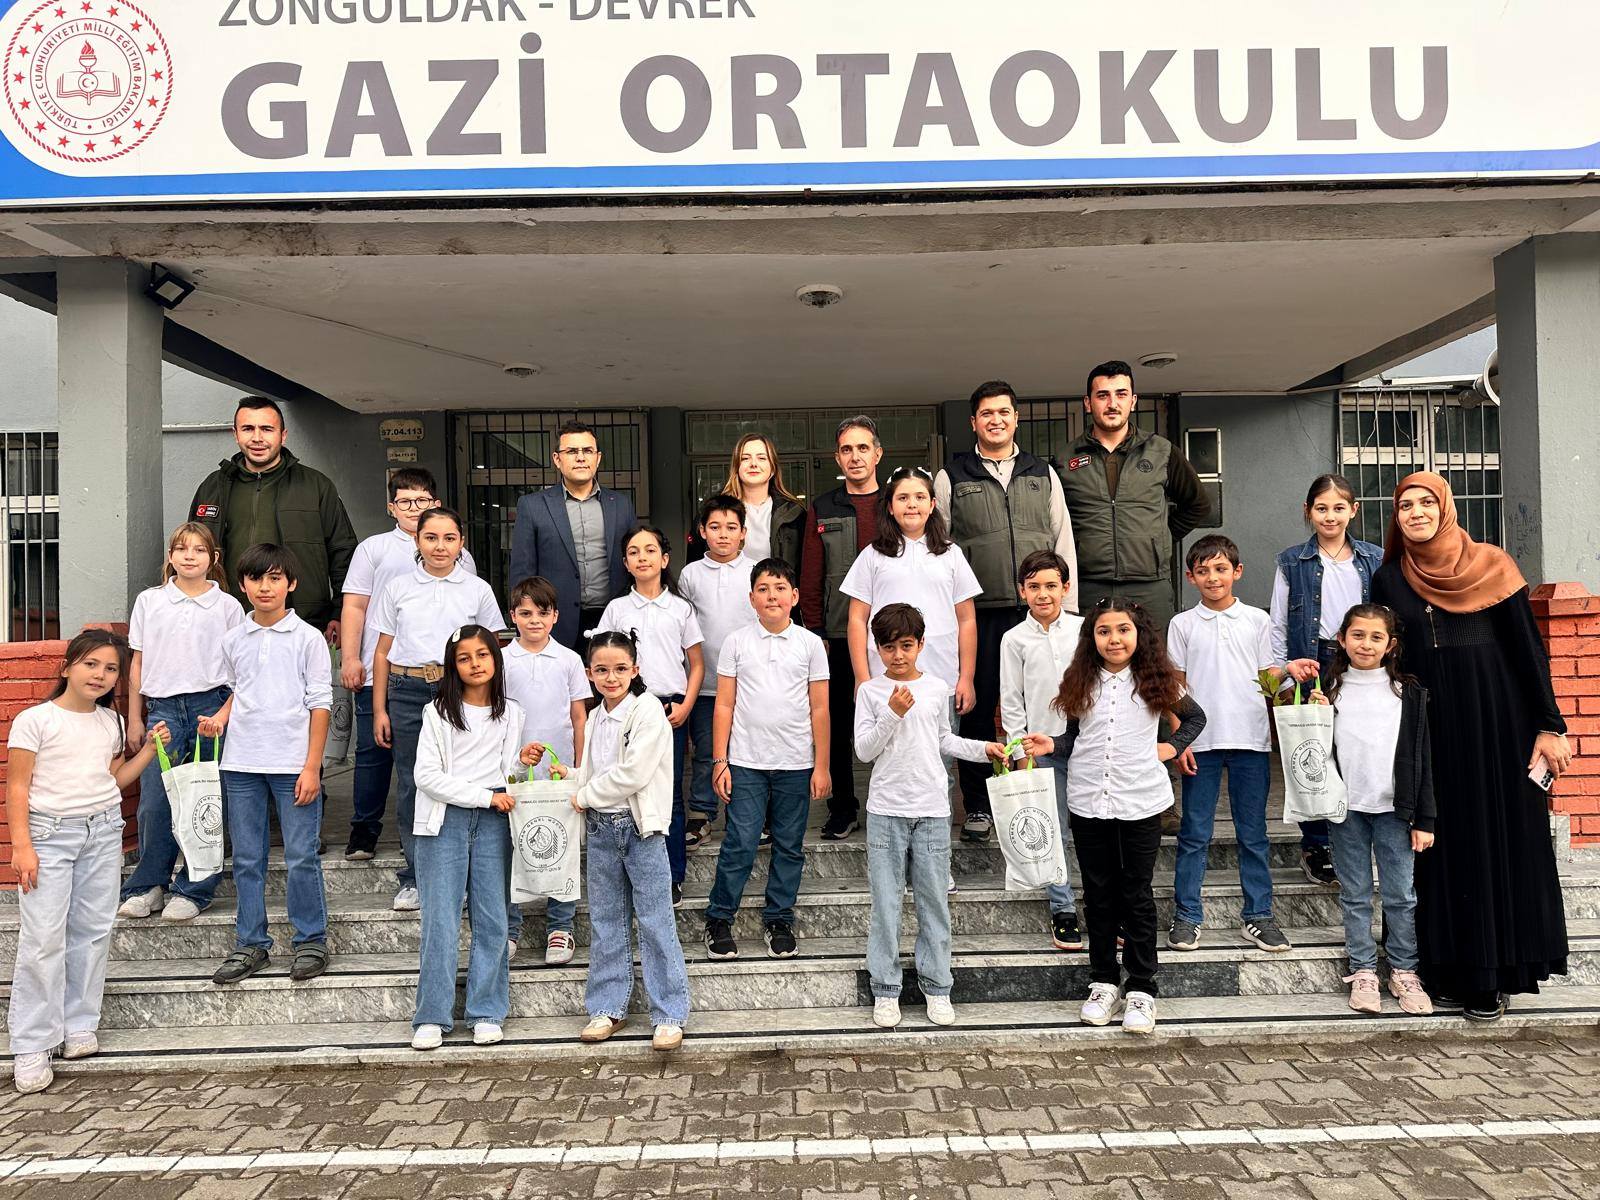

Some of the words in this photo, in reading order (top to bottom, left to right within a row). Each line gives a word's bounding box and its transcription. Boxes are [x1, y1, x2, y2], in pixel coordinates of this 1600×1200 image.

[84, 21, 116, 37] MİLLİ
[219, 0, 527, 26] ZONGULDAK
[570, 0, 756, 20] DEVREK
[35, 22, 80, 90] CUMHURİYETİ
[116, 34, 142, 72] EĞİTİM
[39, 92, 78, 129] TÜRKİYE
[102, 75, 142, 128] BAKANLIĞI
[221, 32, 546, 158] GAZİ
[620, 46, 1449, 153] ORTAOKULU
